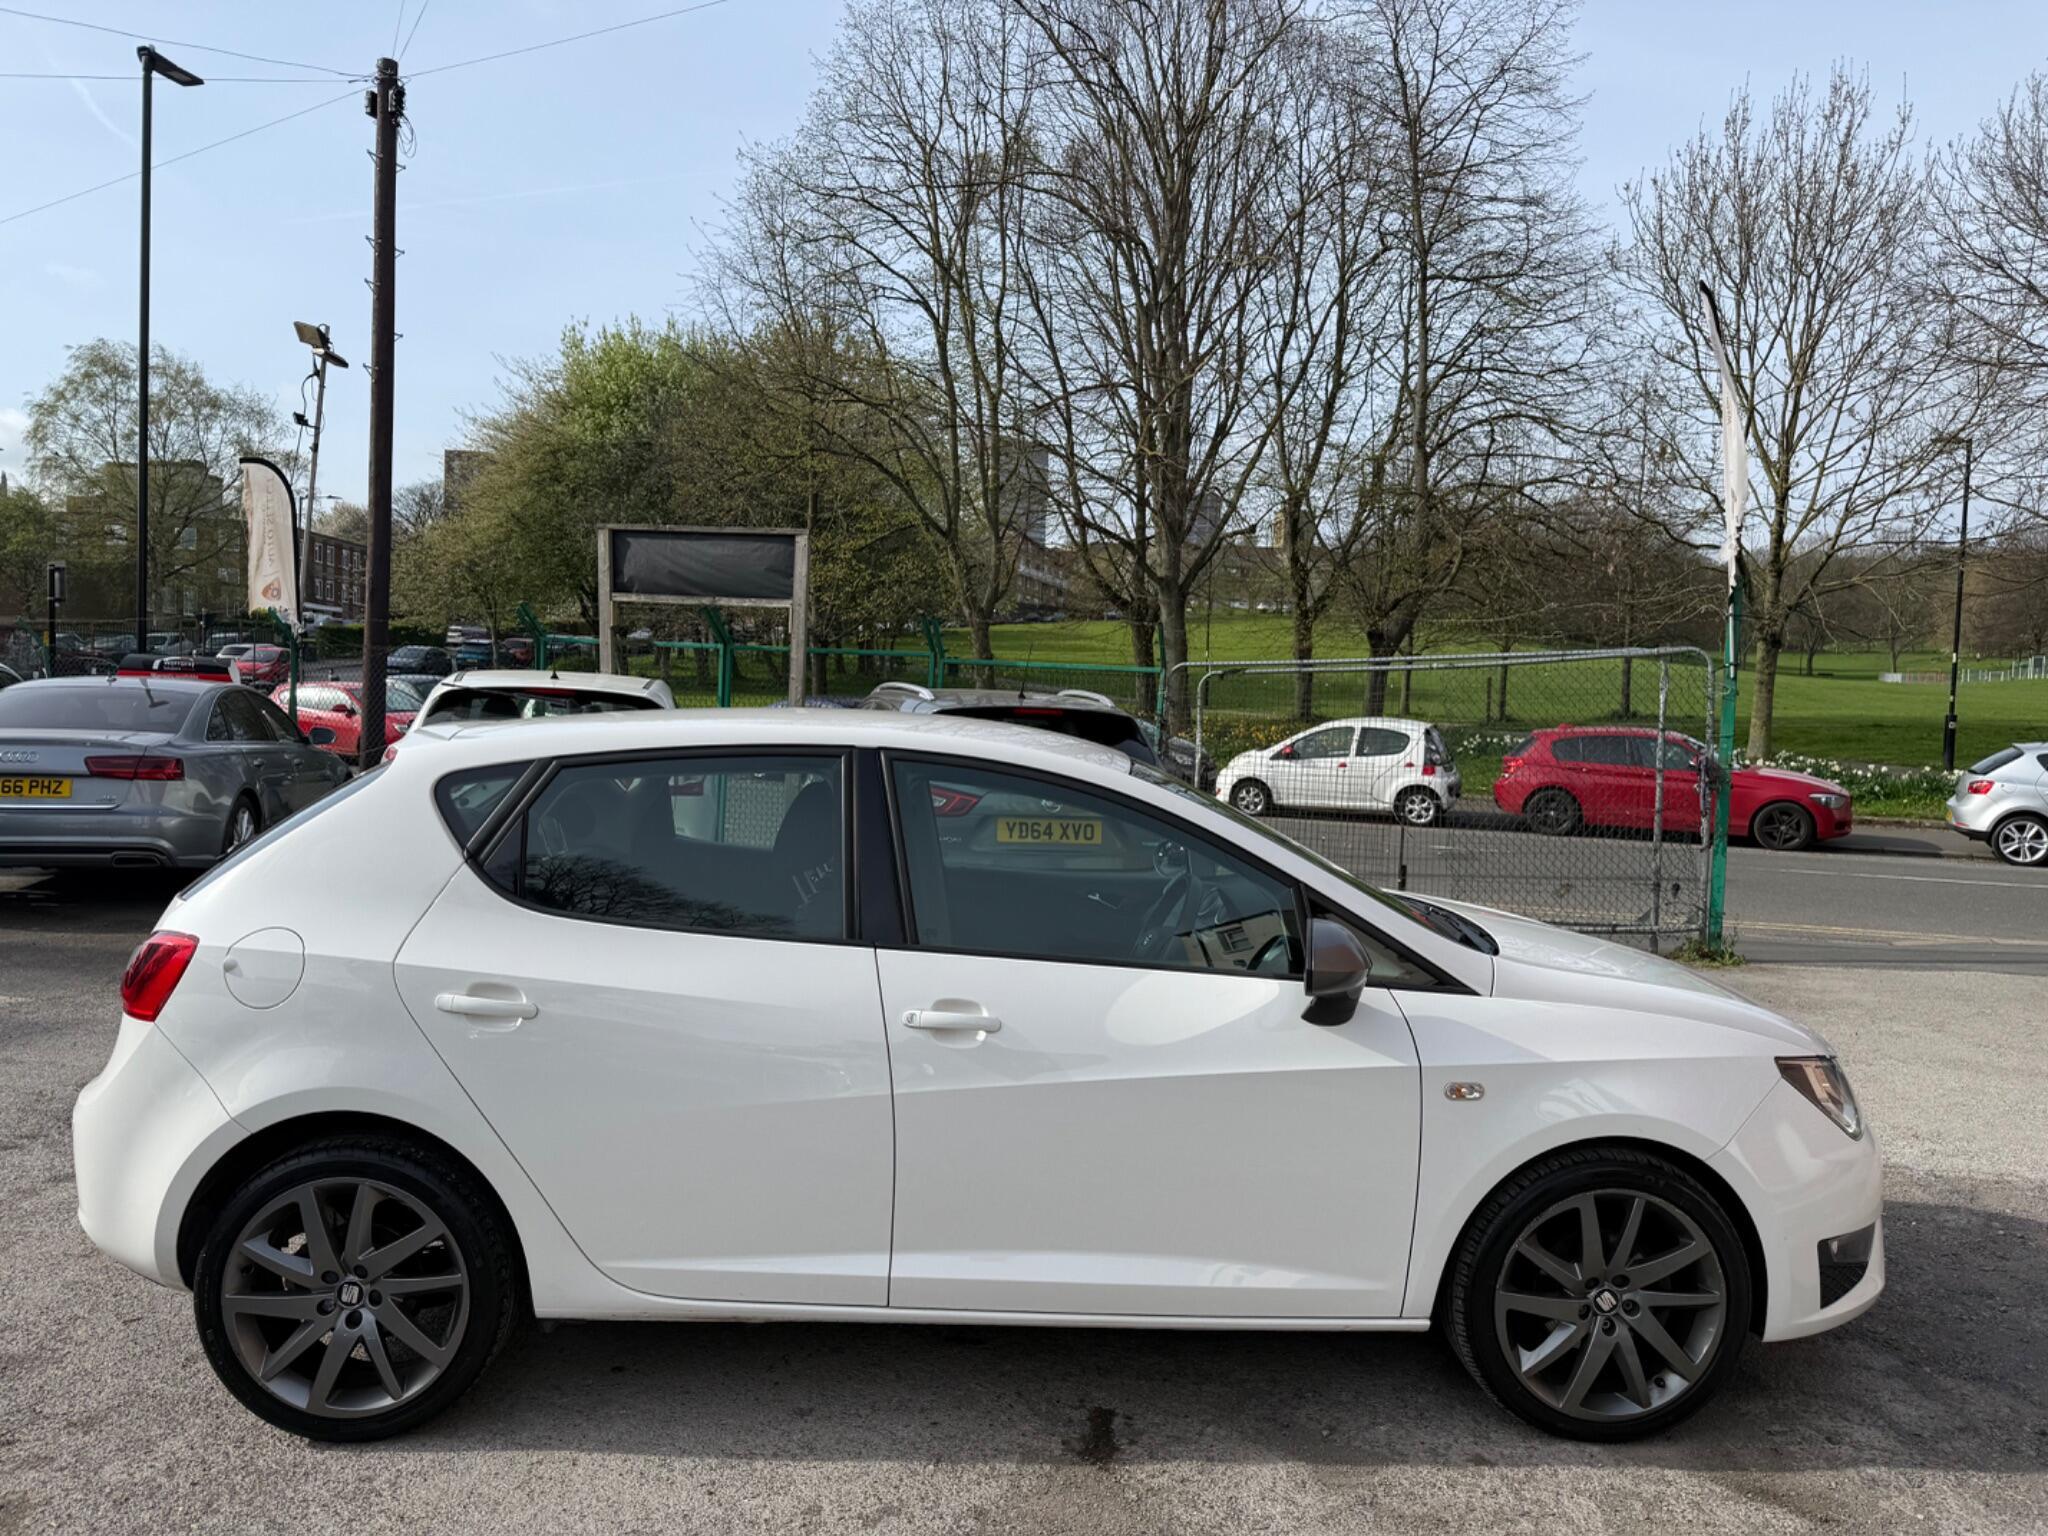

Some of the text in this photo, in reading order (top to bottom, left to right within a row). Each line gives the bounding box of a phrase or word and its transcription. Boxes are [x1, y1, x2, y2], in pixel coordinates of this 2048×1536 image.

[1, 779, 64, 795] 66 PHZ
[1006, 821, 1095, 841] YD64 XVO
